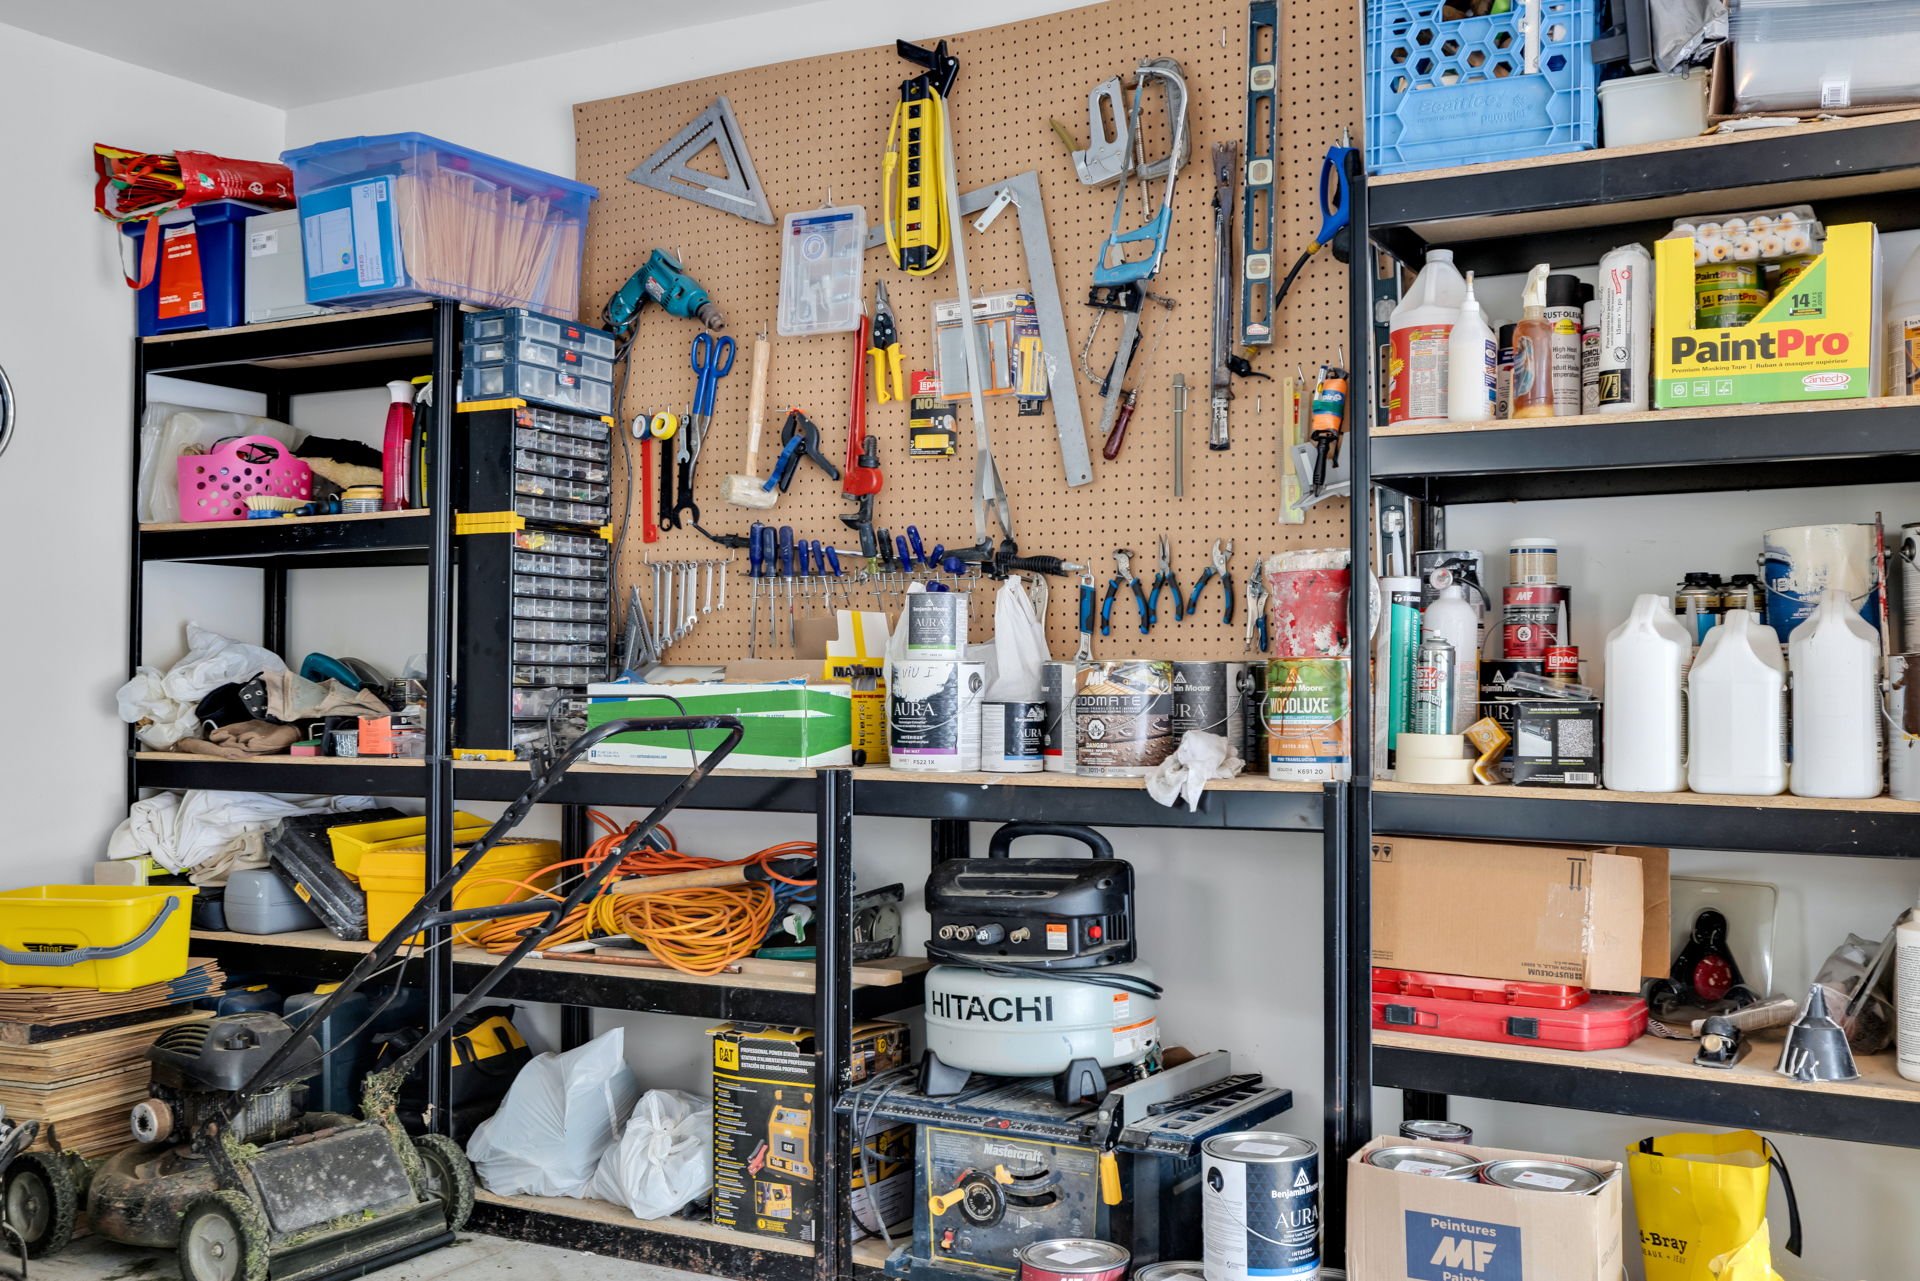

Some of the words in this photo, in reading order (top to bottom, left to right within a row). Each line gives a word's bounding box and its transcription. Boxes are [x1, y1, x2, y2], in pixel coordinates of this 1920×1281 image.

[1717, 293, 1758, 303] PaintPro
[1791, 293, 1811, 308] 14
[1671, 328, 1850, 365] PaintPro
[1785, 361, 1815, 369] masquer
[1803, 373, 1844, 385] cantech
[1516, 592, 1534, 601] MF
[915, 618, 946, 627] AURA
[1299, 684, 1323, 692] Moore
[894, 702, 936, 716] AURA
[1174, 704, 1207, 718] URA
[1270, 697, 1329, 714] WOODLUXE
[1483, 706, 1514, 719] AUR
[1016, 728, 1043, 738] AURA
[1528, 968, 1575, 980] RUST-OLEUM
[931, 990, 1054, 1022] HITACHI
[719, 1047, 734, 1062] CAT
[740, 1047, 769, 1055] PROFESSIONAL
[984, 1143, 1043, 1162] Mastercraft
[1271, 1187, 1305, 1199] Benjamin
[1274, 1204, 1319, 1230] AURA
[1431, 1217, 1497, 1237] Peintures
[1291, 1247, 1313, 1257] INTERIOR
[1430, 1236, 1497, 1272] MF
